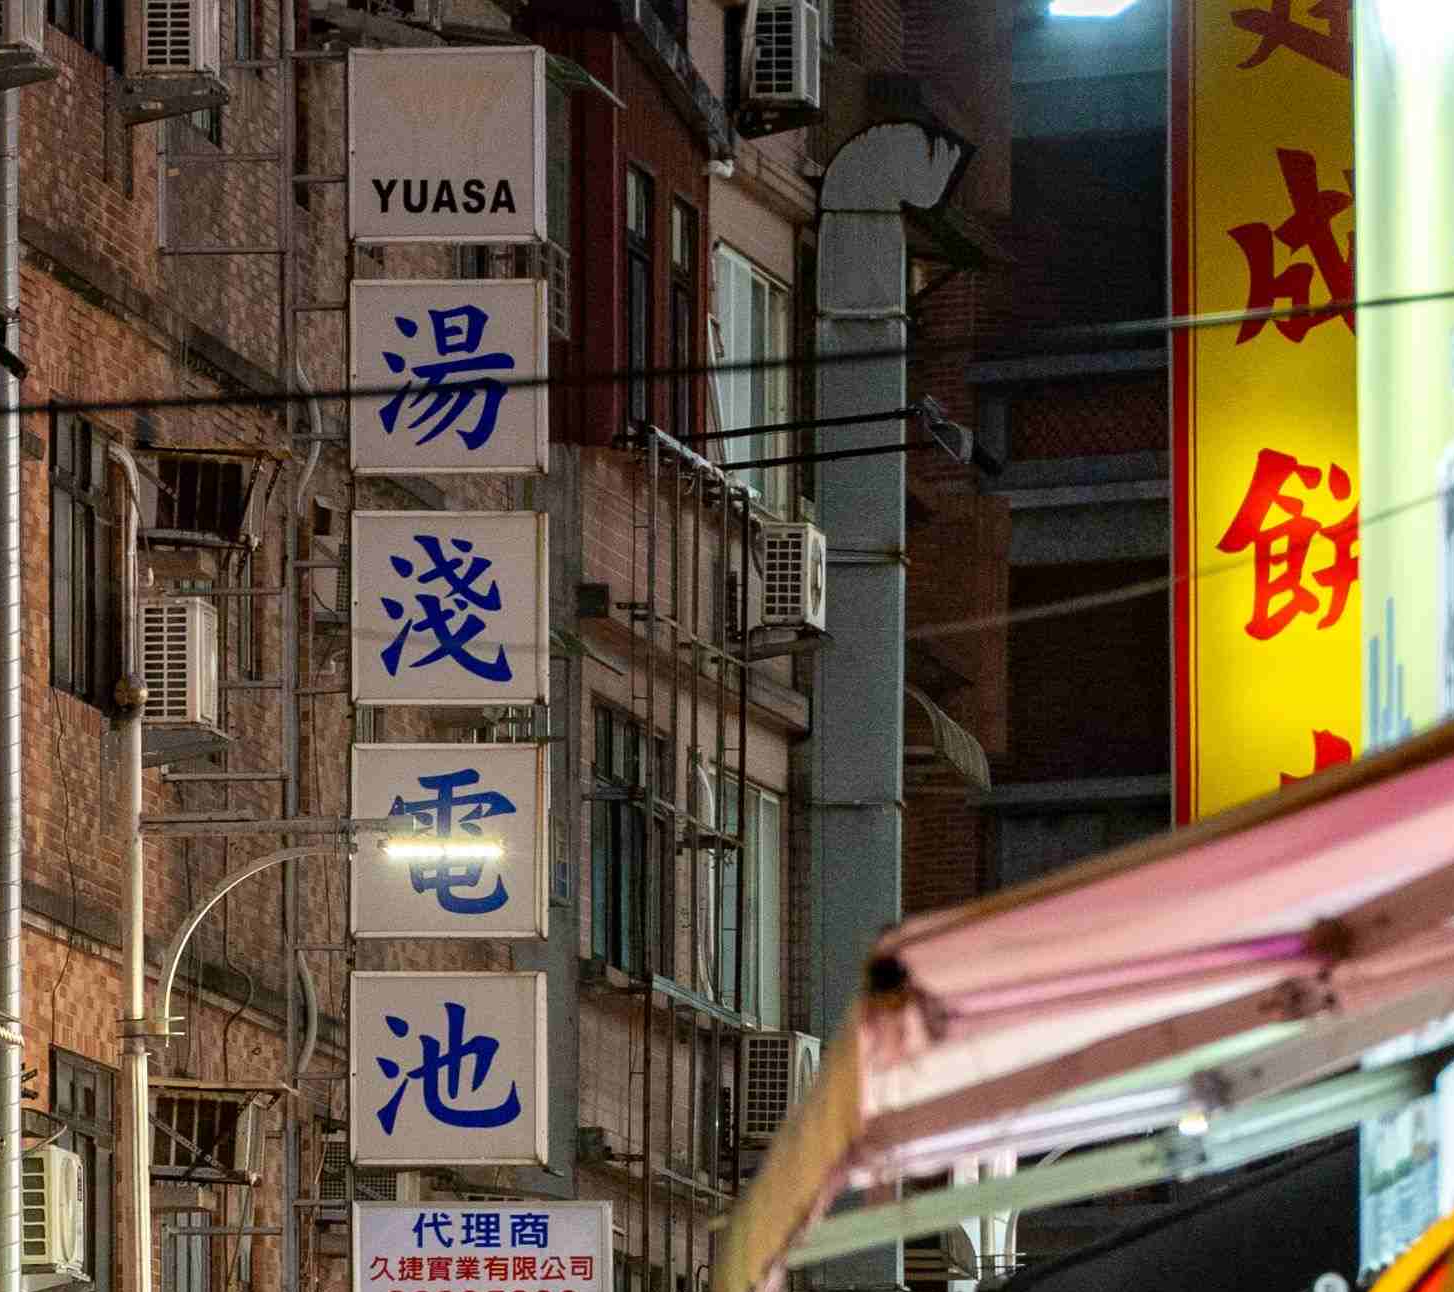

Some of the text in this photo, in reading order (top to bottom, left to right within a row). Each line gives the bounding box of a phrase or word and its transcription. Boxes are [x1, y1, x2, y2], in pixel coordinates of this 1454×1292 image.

[371, 179, 517, 214] YUASA
[412, 1213, 550, 1248] 代理商
[369, 1256, 594, 1281] 久捷實業有限公司
